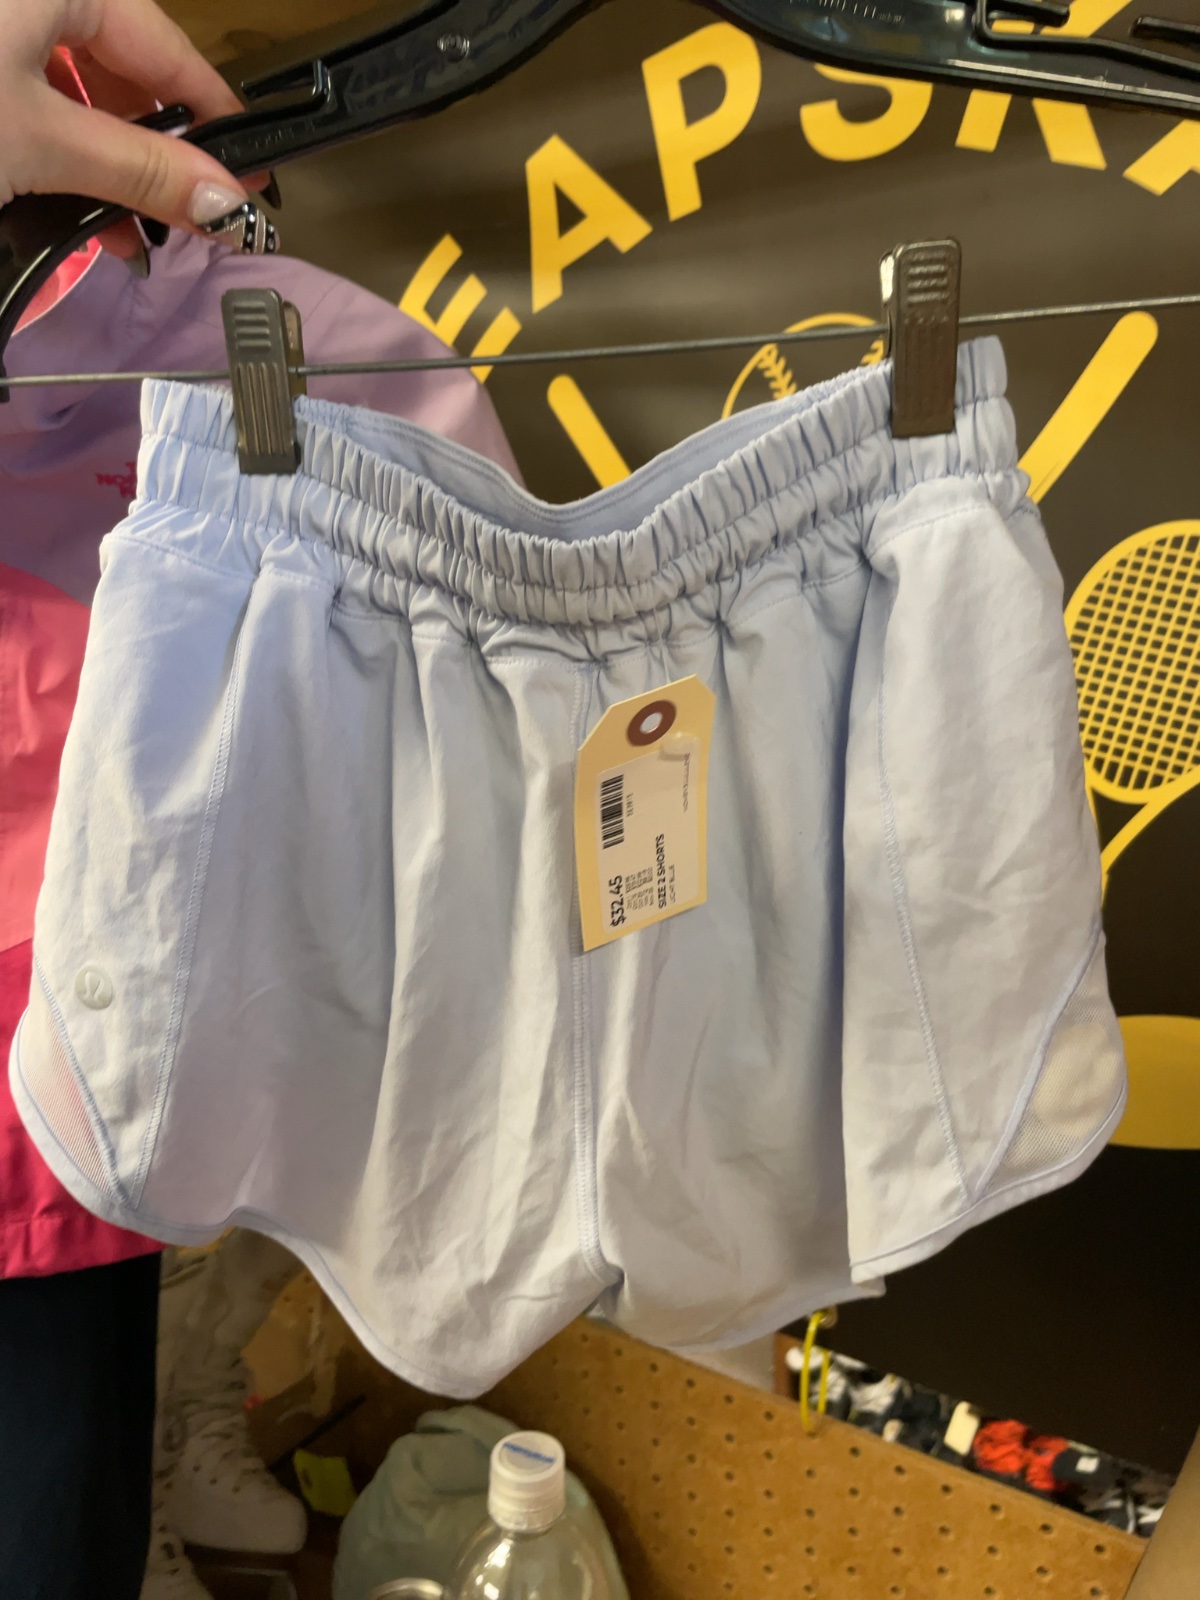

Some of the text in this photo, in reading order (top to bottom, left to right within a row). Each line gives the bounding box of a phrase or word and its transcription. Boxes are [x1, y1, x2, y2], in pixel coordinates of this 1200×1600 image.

[608, 874, 627, 927] $32.45
[655, 833, 667, 909] SIZE 2 SHORTS
